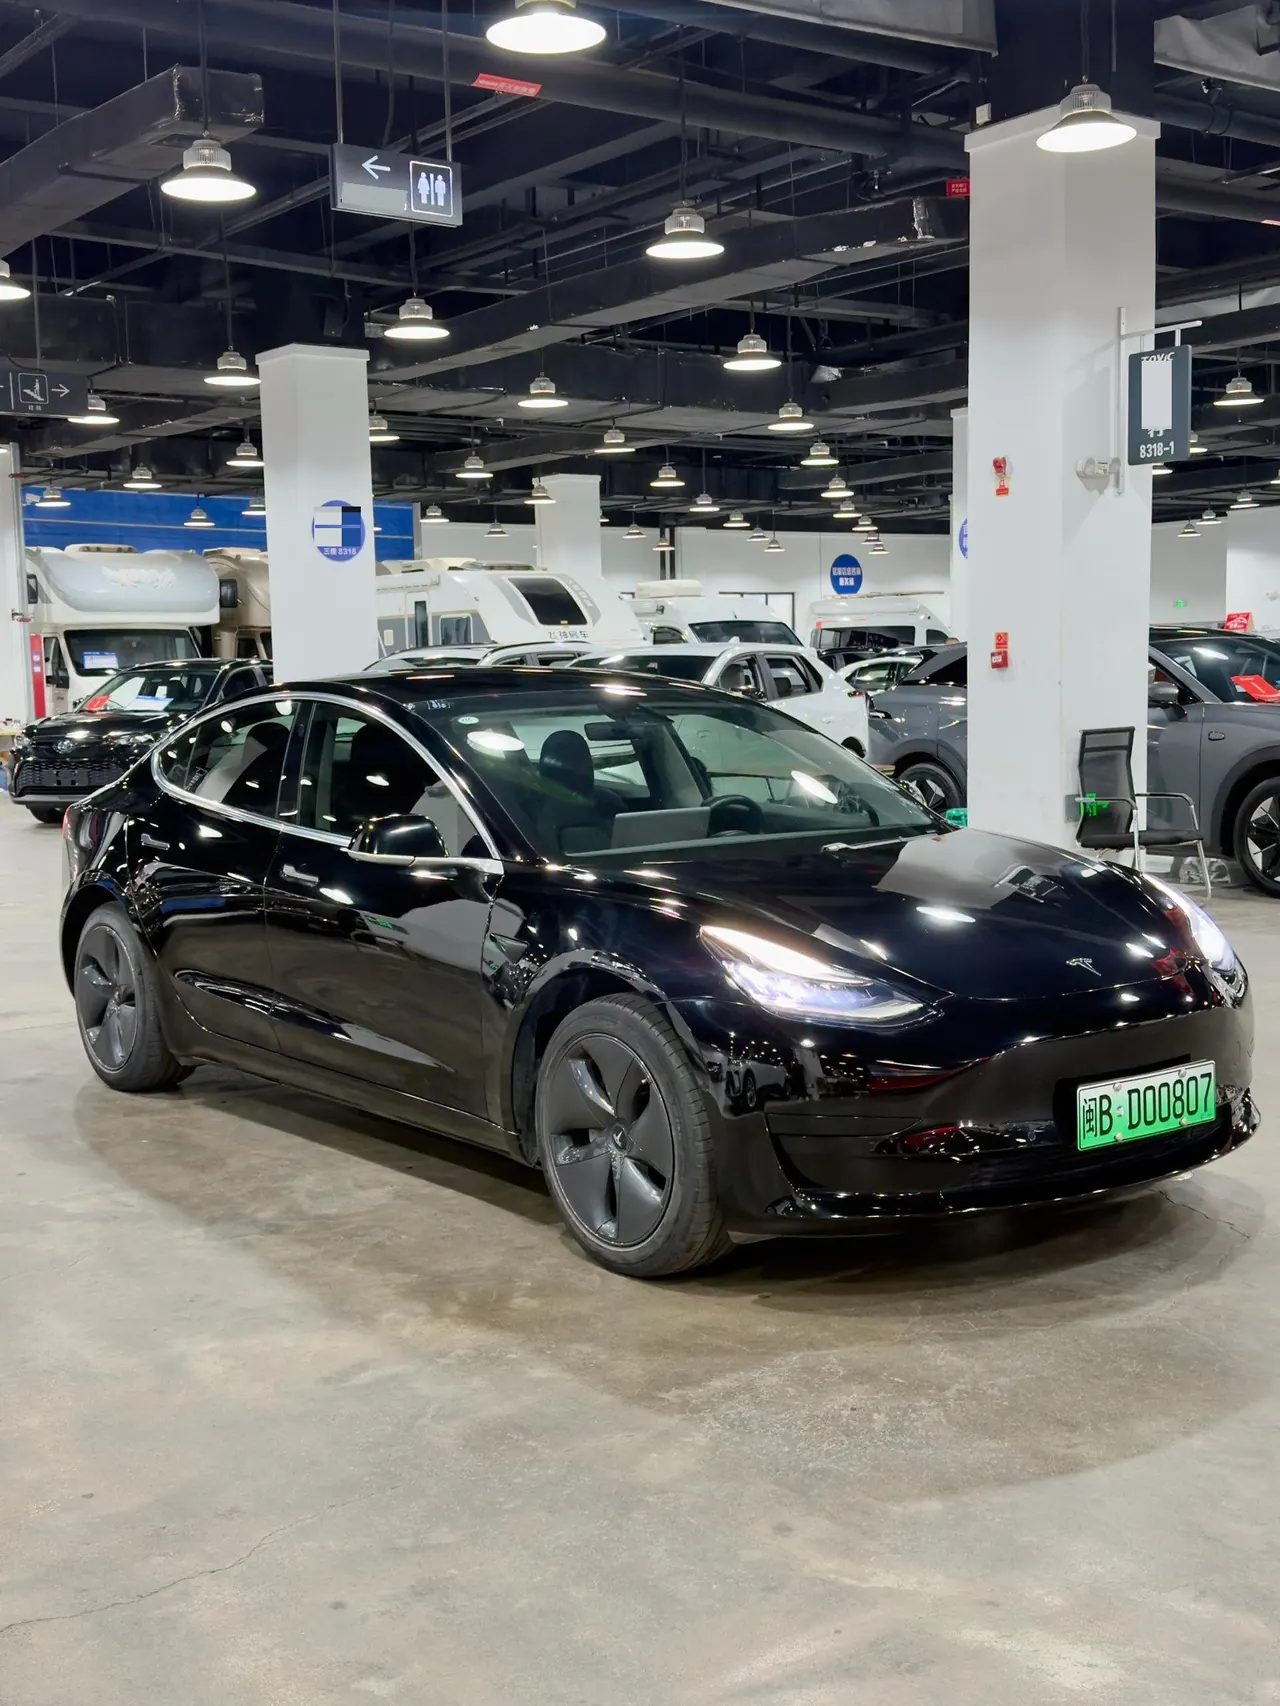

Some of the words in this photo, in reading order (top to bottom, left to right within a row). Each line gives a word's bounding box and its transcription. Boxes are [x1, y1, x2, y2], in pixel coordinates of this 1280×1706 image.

[1140, 441, 1174, 458] 8318-1
[1082, 1094, 1113, 1139] 闽B
[1127, 1072, 1212, 1130] D00807
